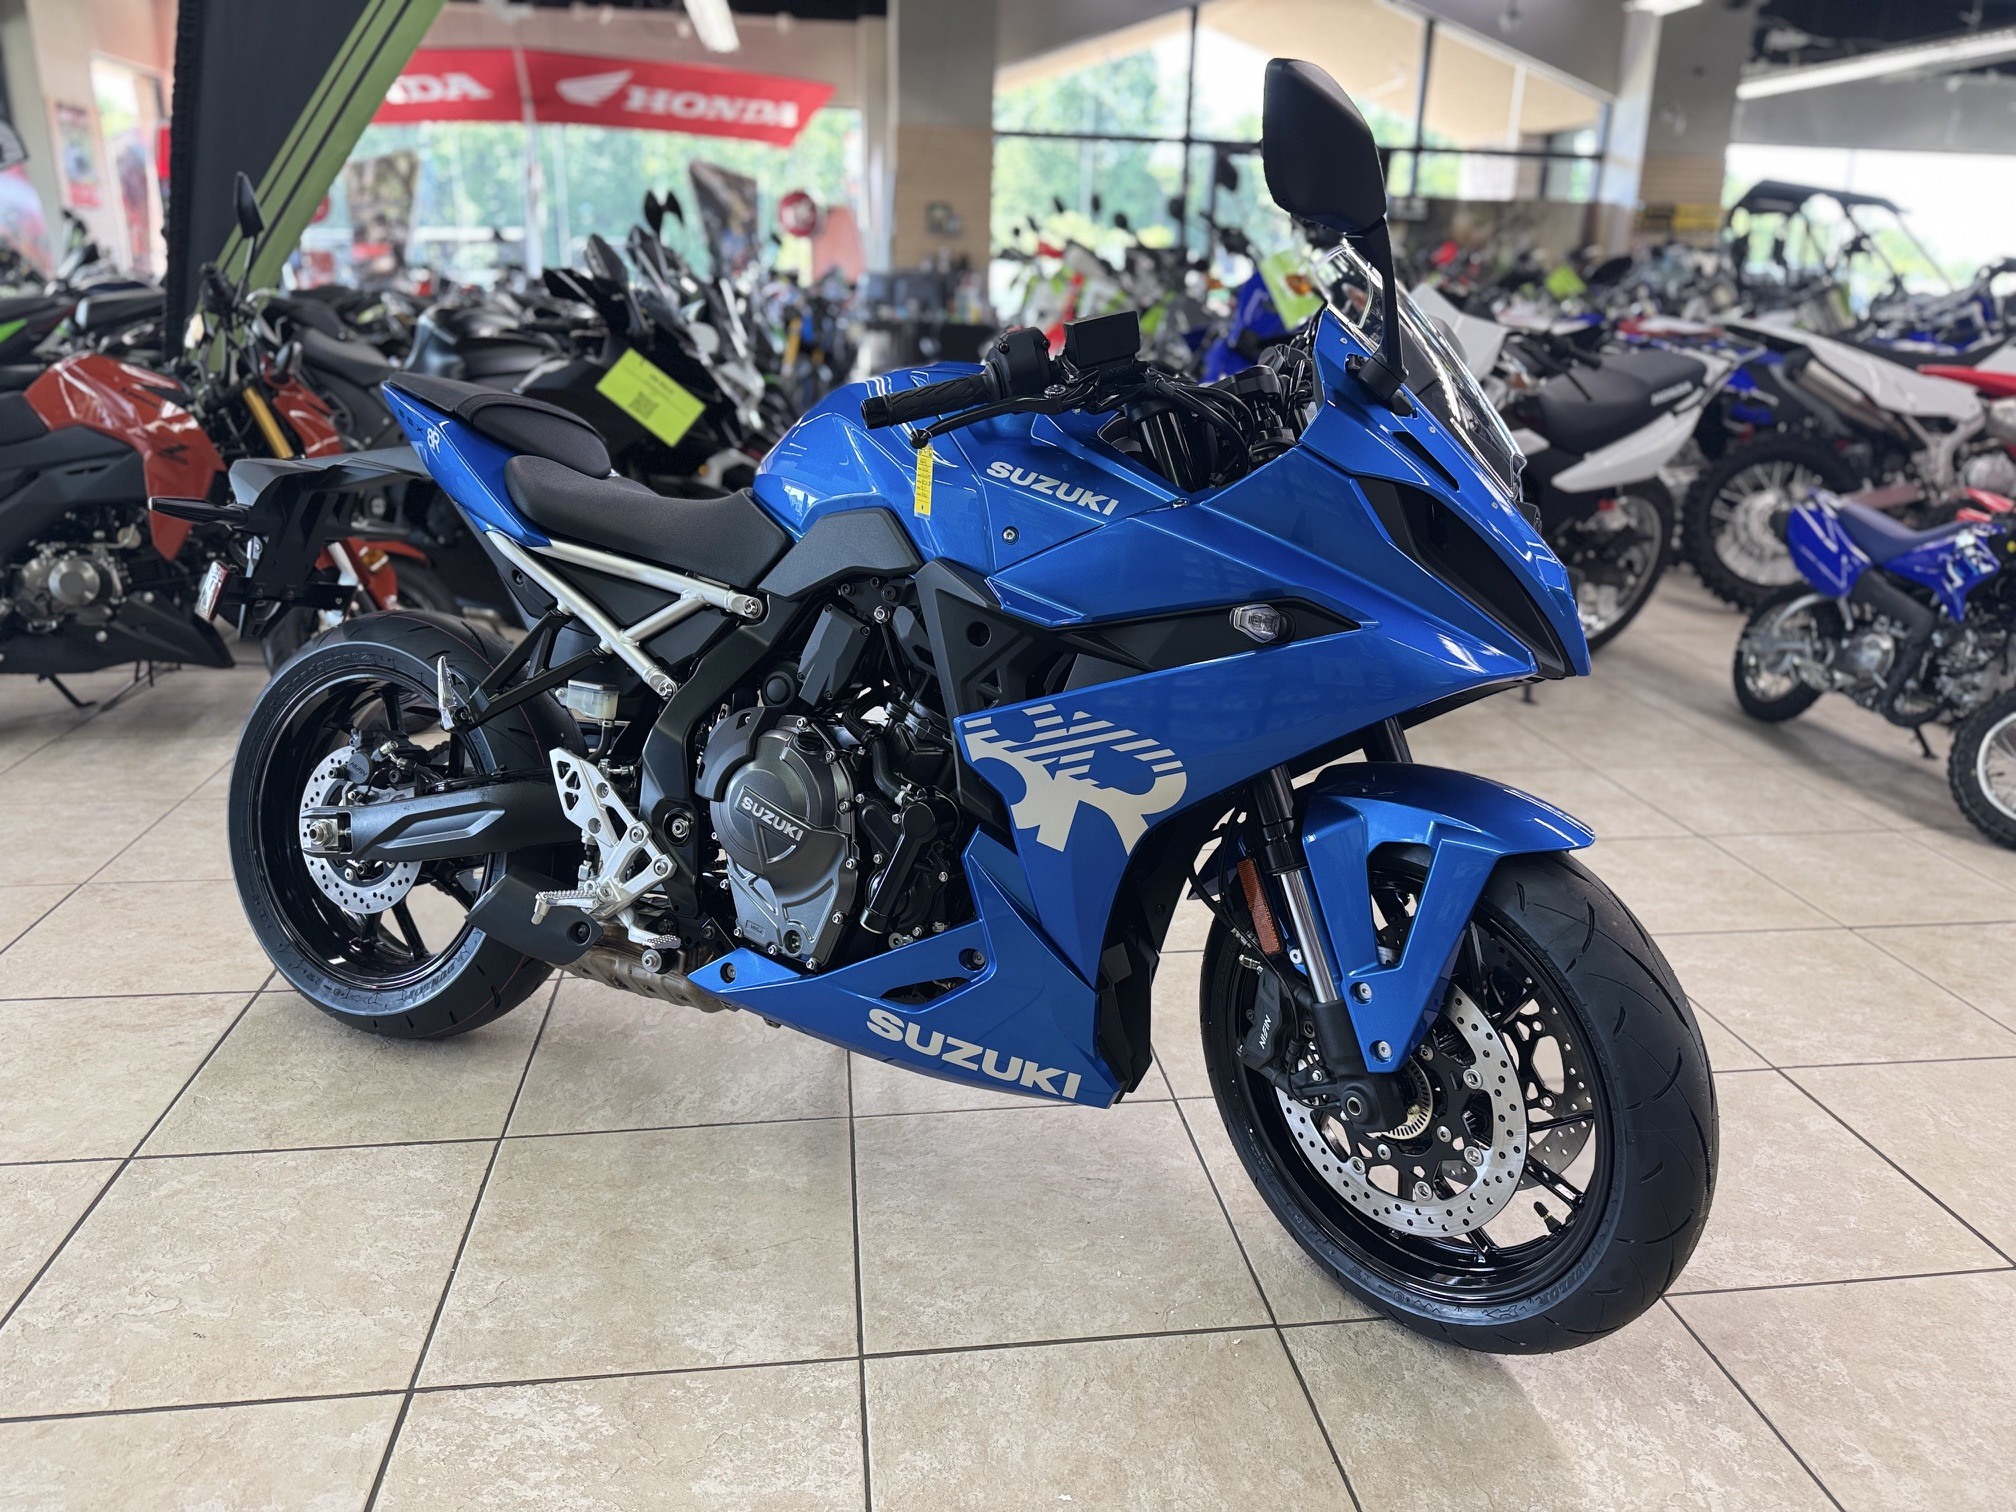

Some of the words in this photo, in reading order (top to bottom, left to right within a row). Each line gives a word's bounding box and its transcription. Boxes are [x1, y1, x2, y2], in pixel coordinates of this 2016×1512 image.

[623, 84, 798, 128] HONDA
[986, 461, 1120, 516] SUZUKI
[741, 796, 804, 841] SUZUKI
[866, 1008, 1082, 1099] SUZUKI
